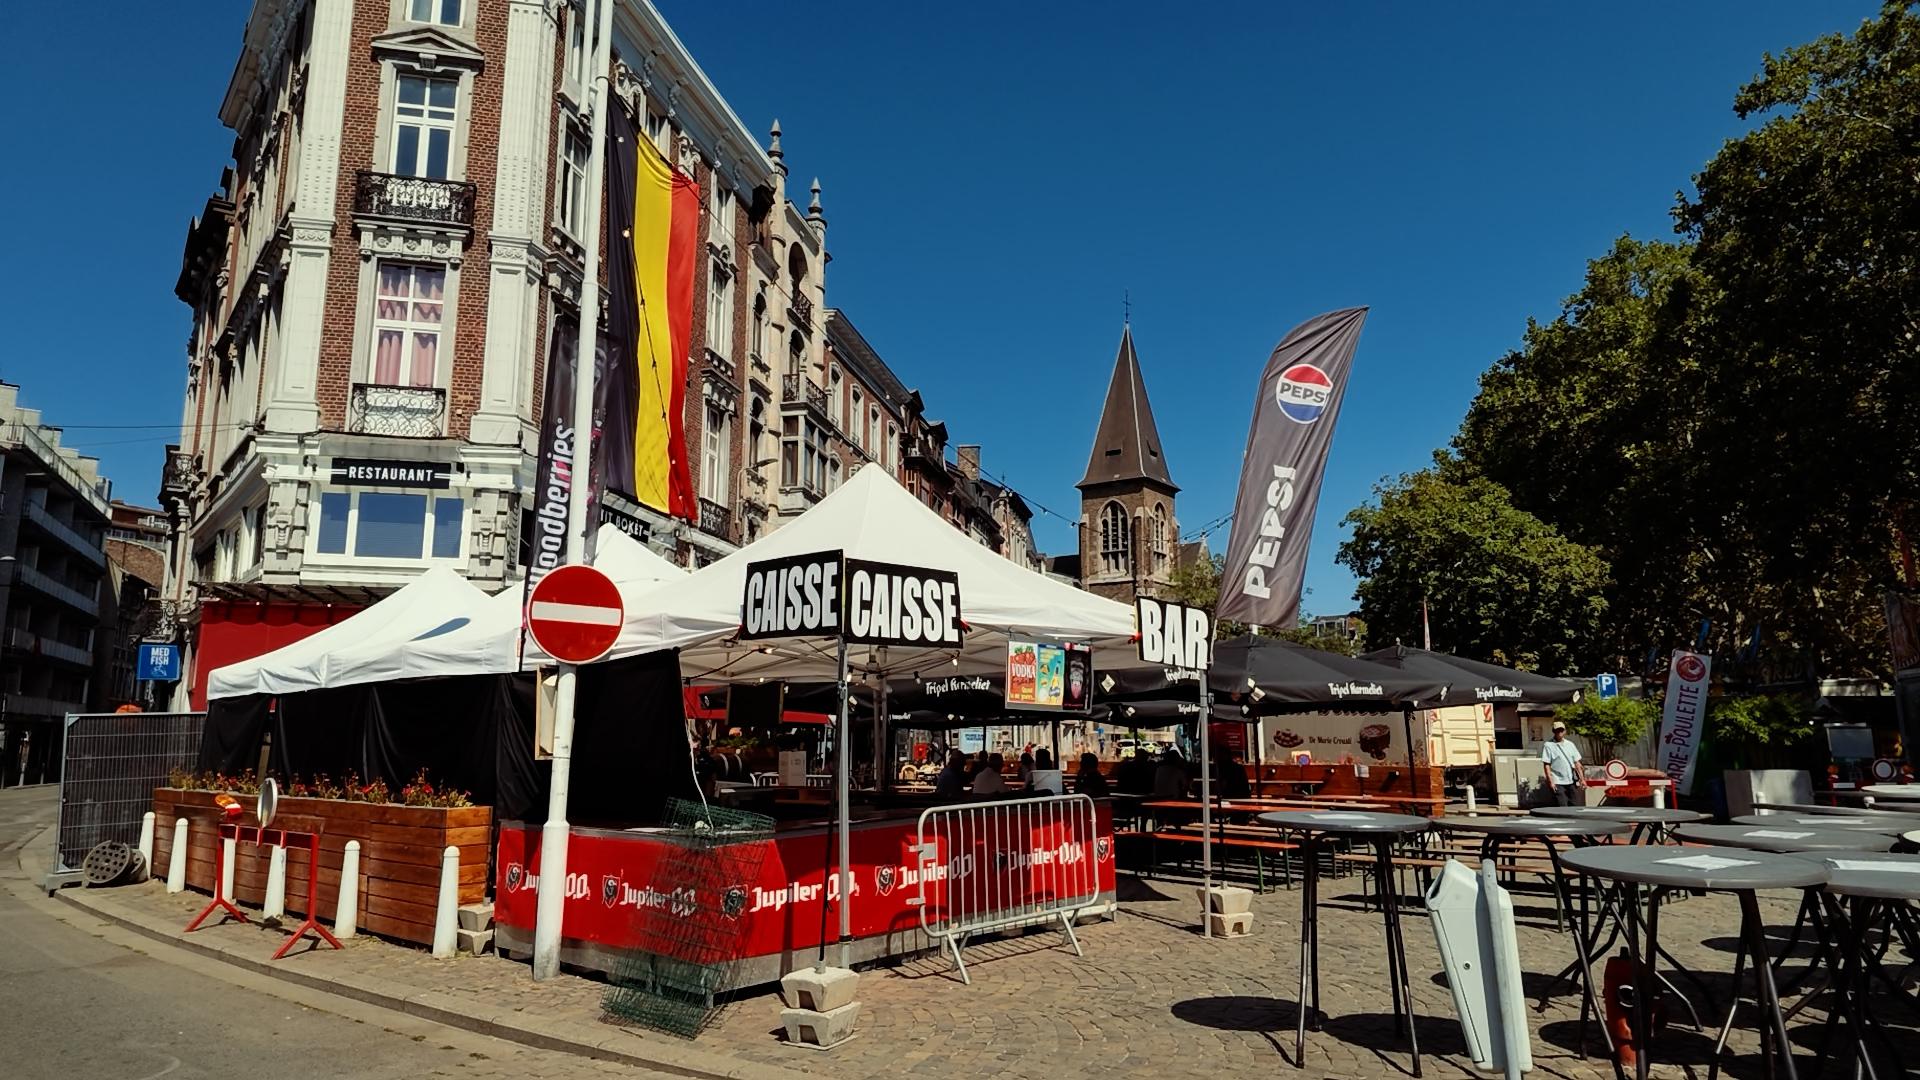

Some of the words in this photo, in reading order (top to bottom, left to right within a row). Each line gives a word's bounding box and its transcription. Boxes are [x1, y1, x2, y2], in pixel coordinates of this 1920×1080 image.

[348, 466, 433, 482] RESTAURANT
[1243, 464, 1297, 600] PEPSI
[747, 561, 838, 635] CAISSE
[851, 569, 959, 642] CAISSE
[1140, 598, 1209, 670] BAR
[150, 656, 169, 666] FISH
[151, 647, 170, 657] MED
[926, 678, 949, 697] Tripel
[1602, 676, 1613, 691] P
[1010, 847, 1059, 871] Jupiler
[619, 882, 671, 910] Jupiler
[748, 881, 823, 913] Jupiler
